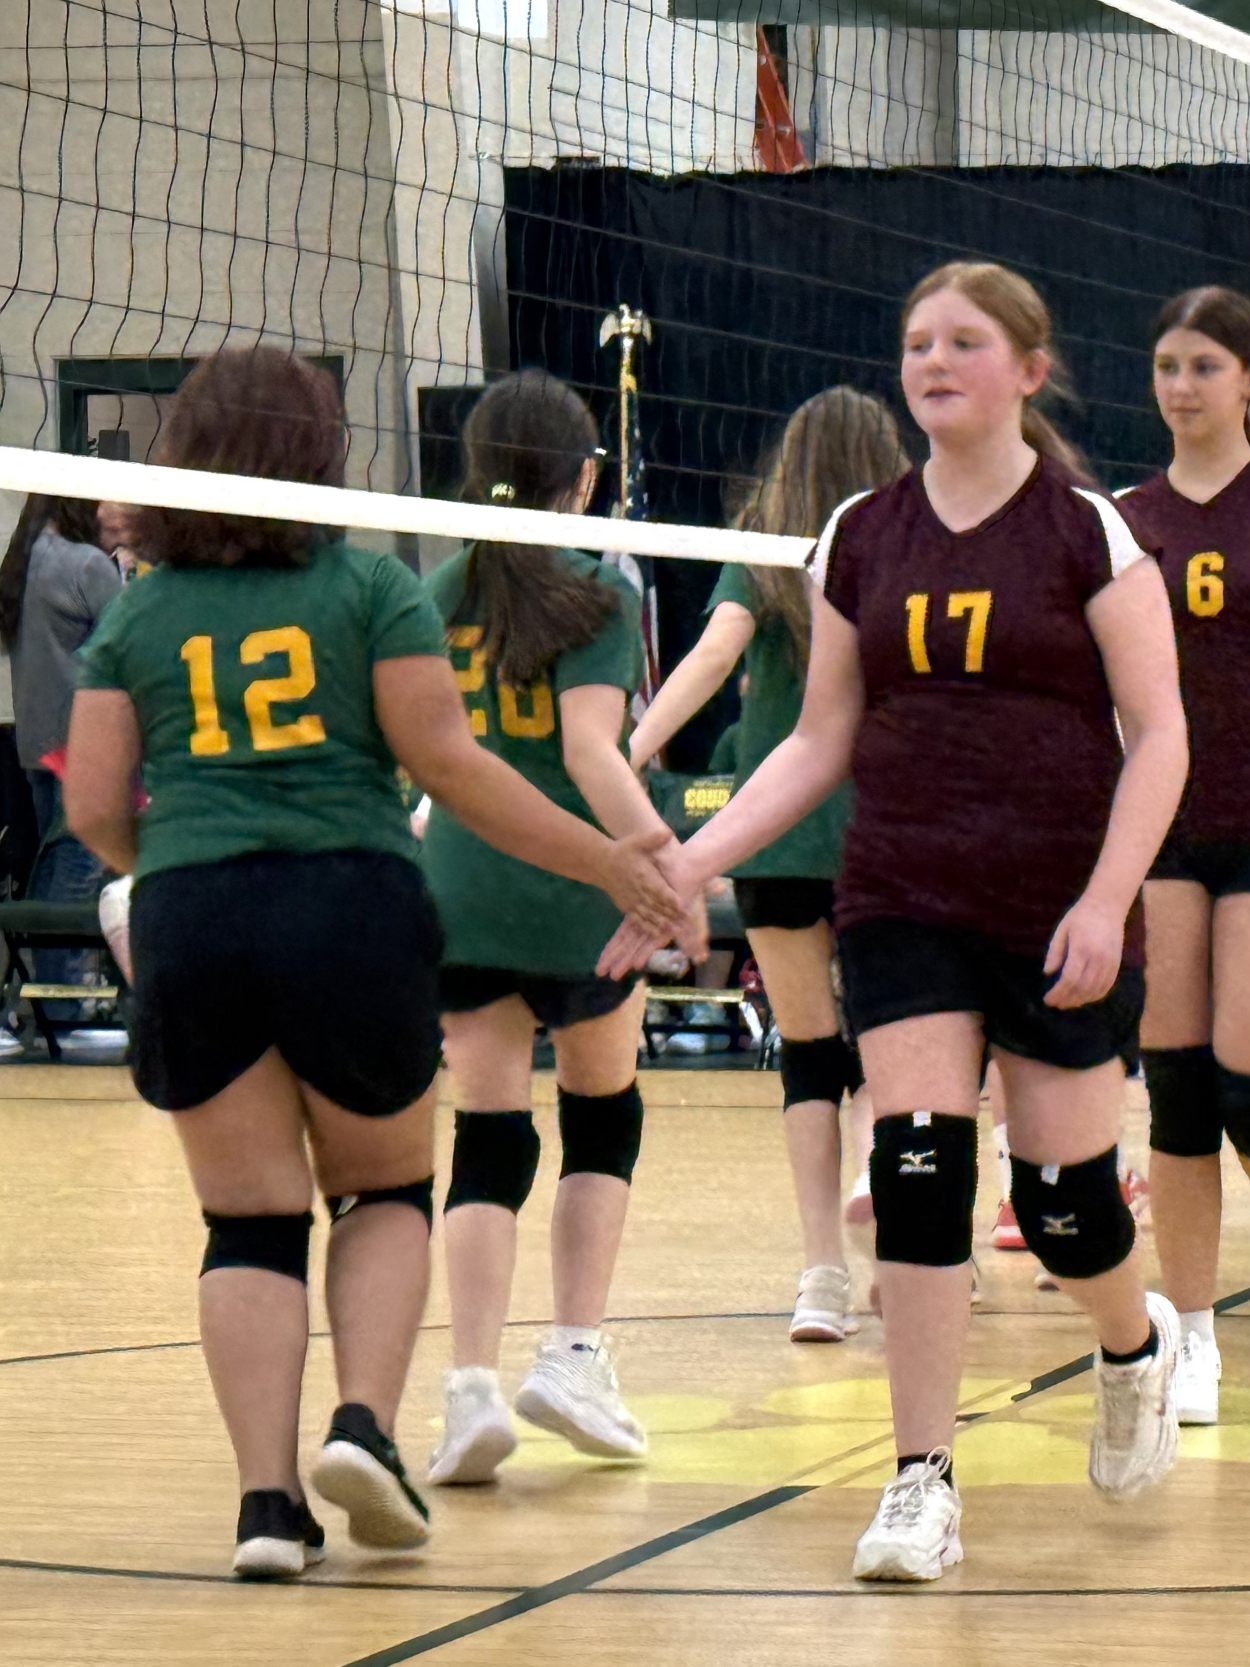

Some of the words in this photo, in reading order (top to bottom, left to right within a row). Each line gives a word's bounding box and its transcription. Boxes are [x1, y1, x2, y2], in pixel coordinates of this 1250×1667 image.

[1187, 551, 1224, 617] 6
[905, 590, 992, 673] 17
[180, 625, 326, 756] 12
